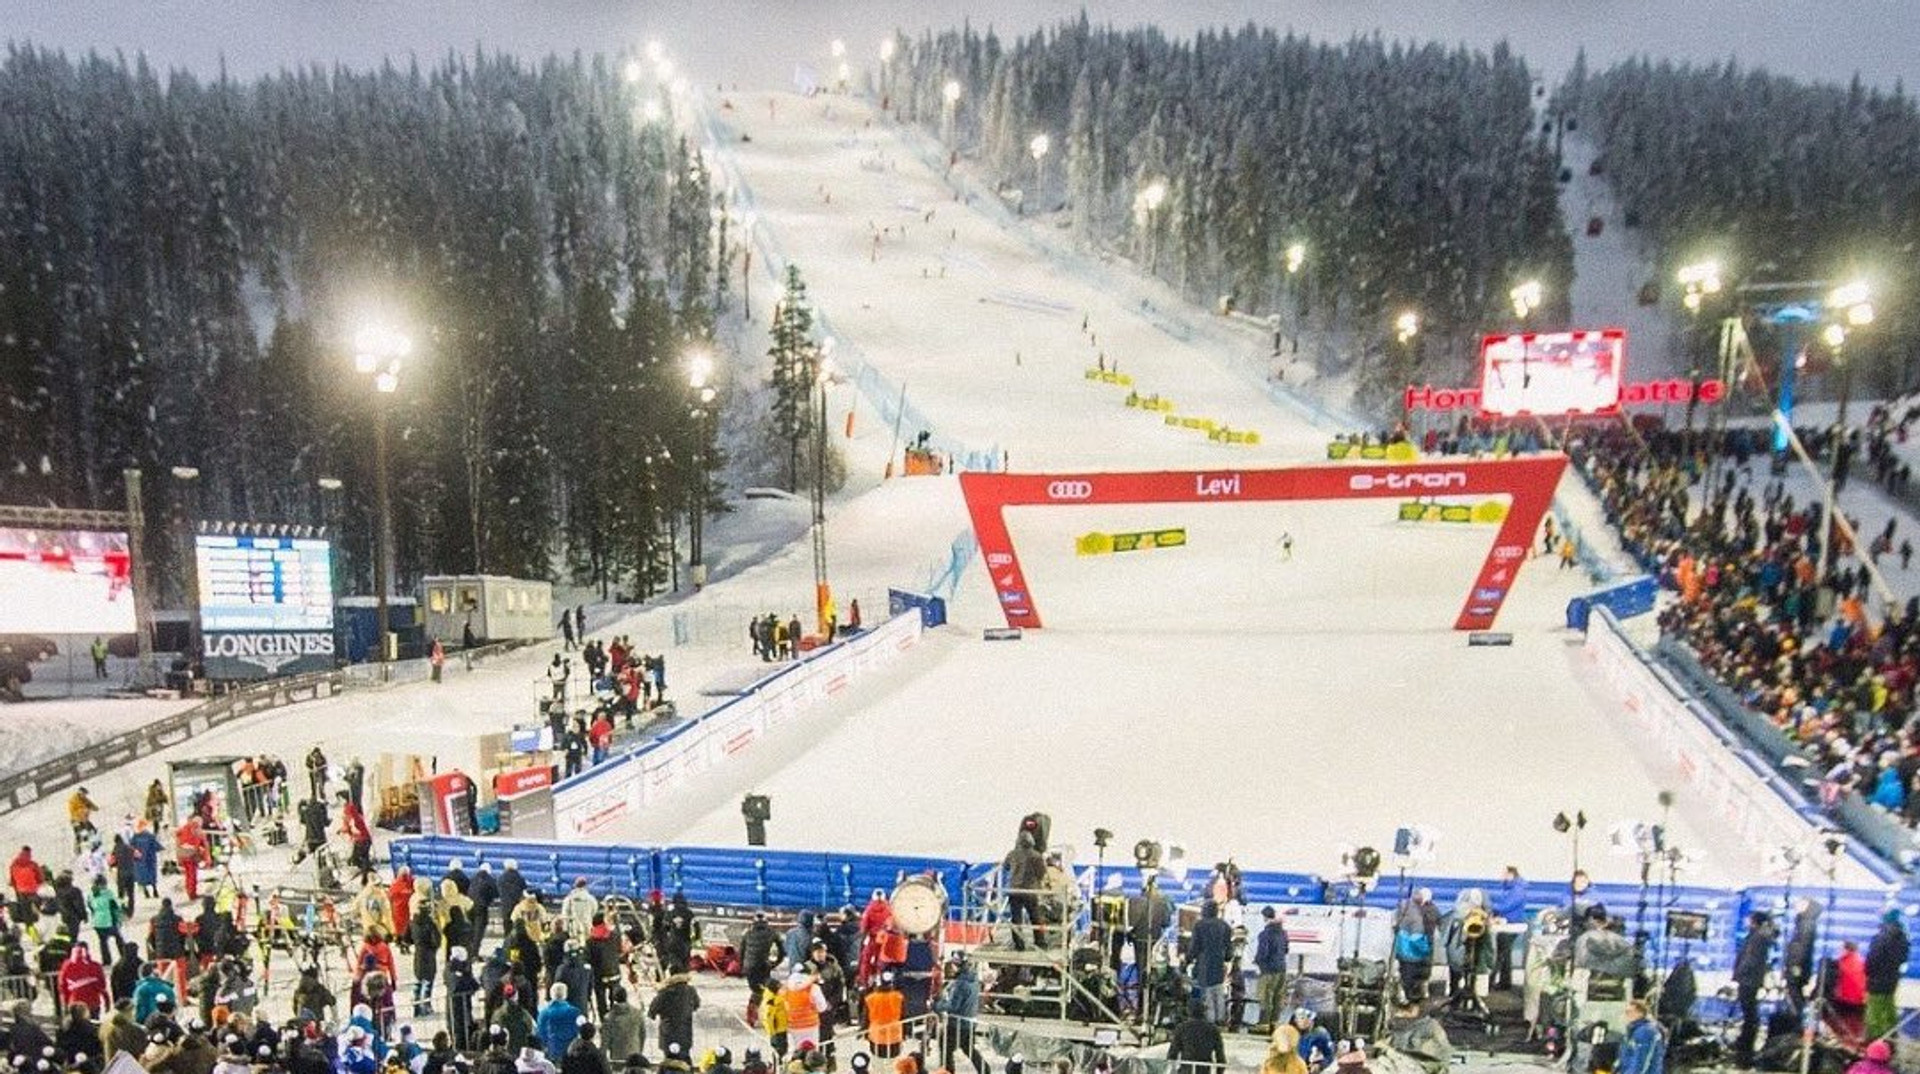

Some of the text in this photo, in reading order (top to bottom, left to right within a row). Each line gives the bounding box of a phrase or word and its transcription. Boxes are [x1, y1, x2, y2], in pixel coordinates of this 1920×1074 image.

[1196, 473, 1241, 495] Levi
[1349, 471, 1467, 490] e-tron
[203, 632, 336, 657] LONGINES
